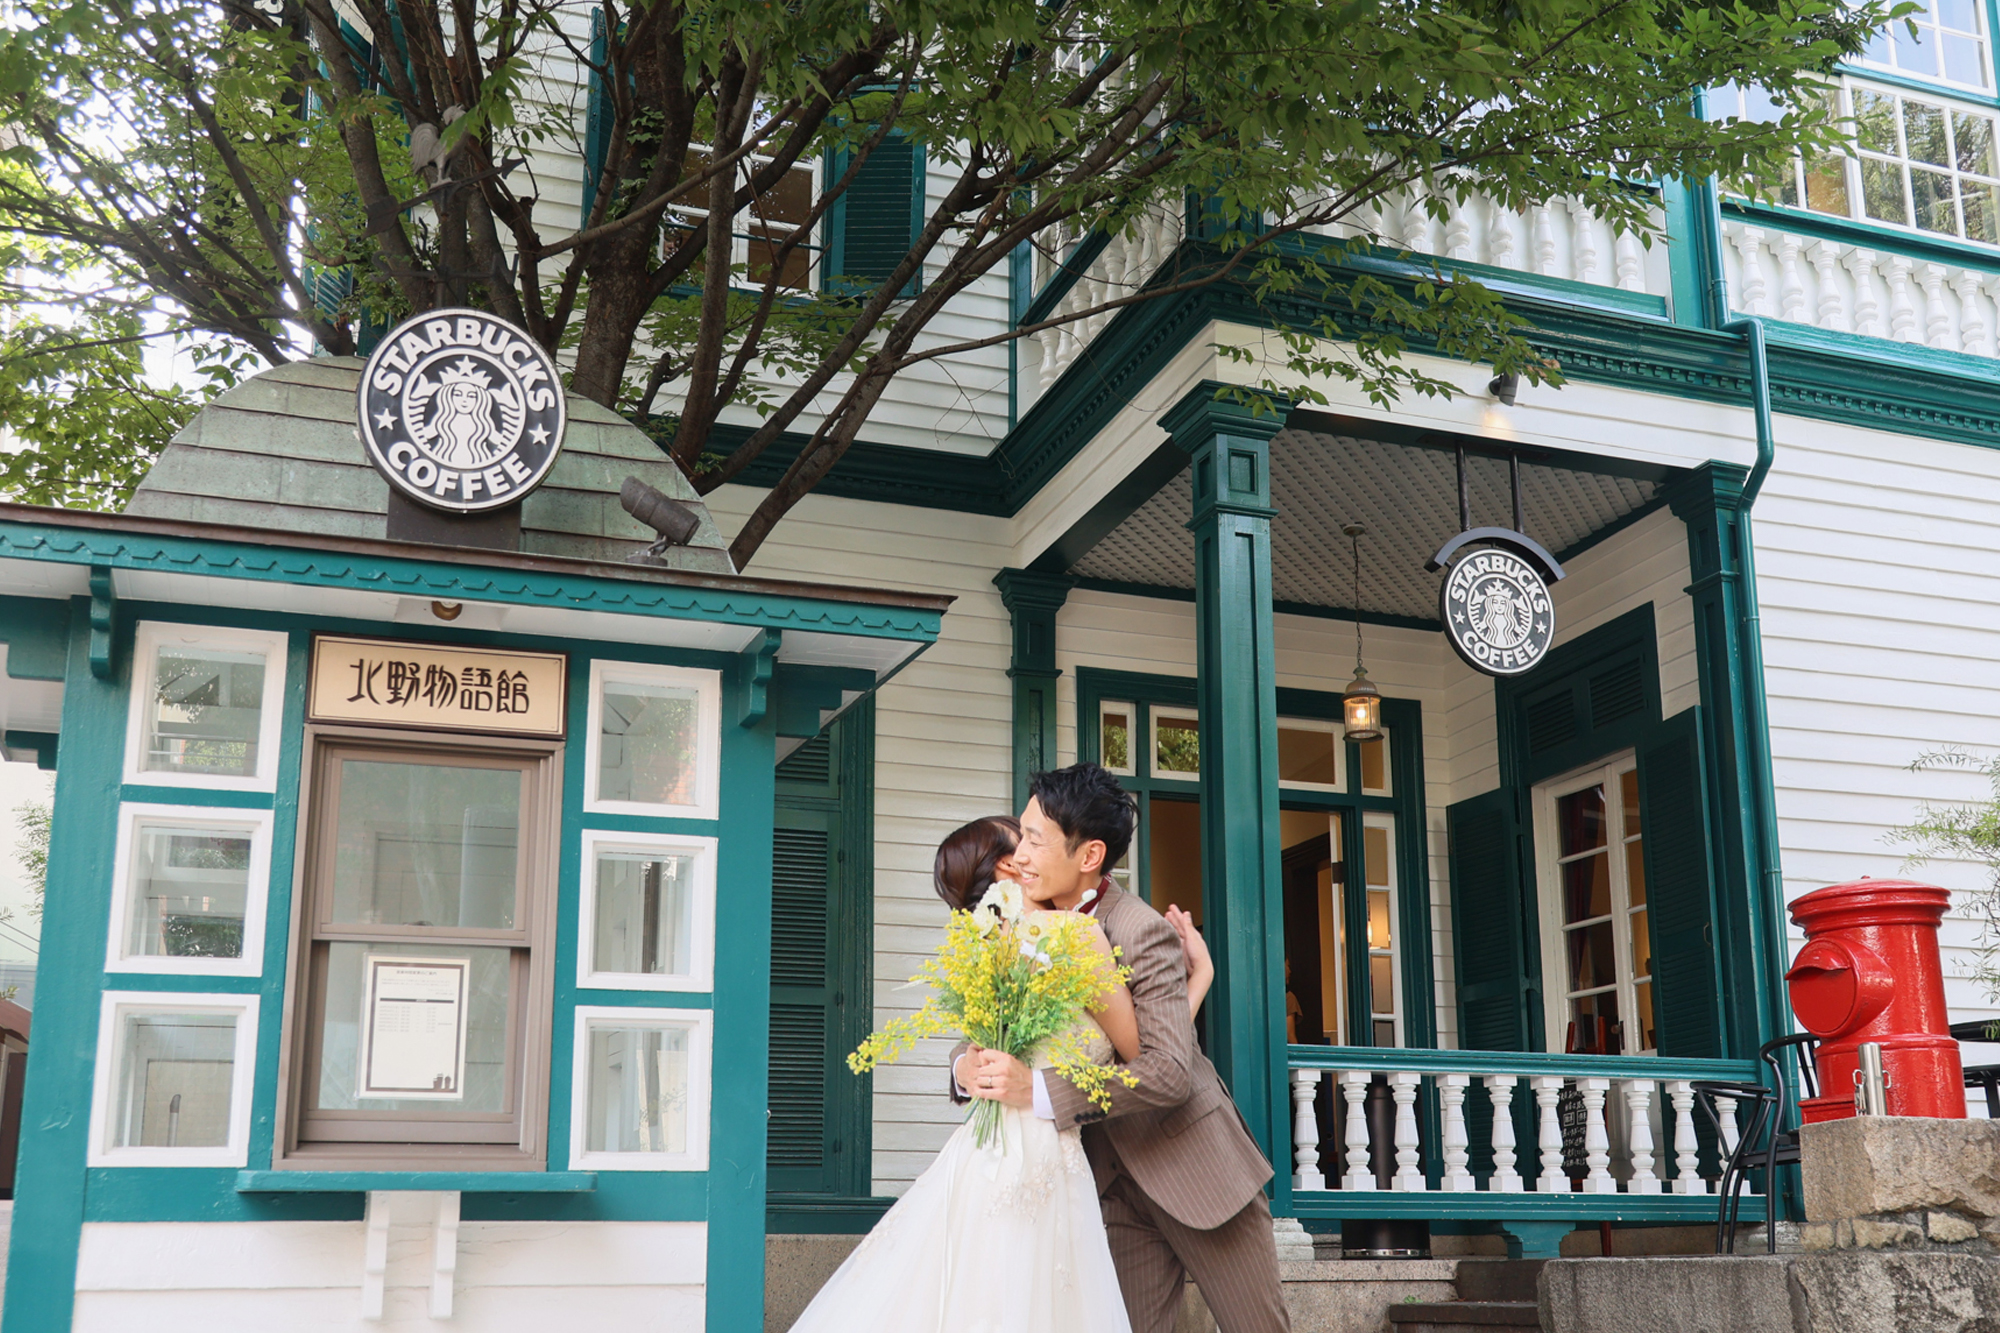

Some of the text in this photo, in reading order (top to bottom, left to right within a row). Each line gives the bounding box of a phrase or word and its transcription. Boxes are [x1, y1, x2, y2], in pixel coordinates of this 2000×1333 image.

[373, 318, 555, 411] STARBUCKS
[388, 441, 532, 500] COFFEE
[1450, 555, 1548, 614] STARBUCKS
[1462, 630, 1539, 668] COFFEE
[346, 658, 530, 714] 北野物語館
